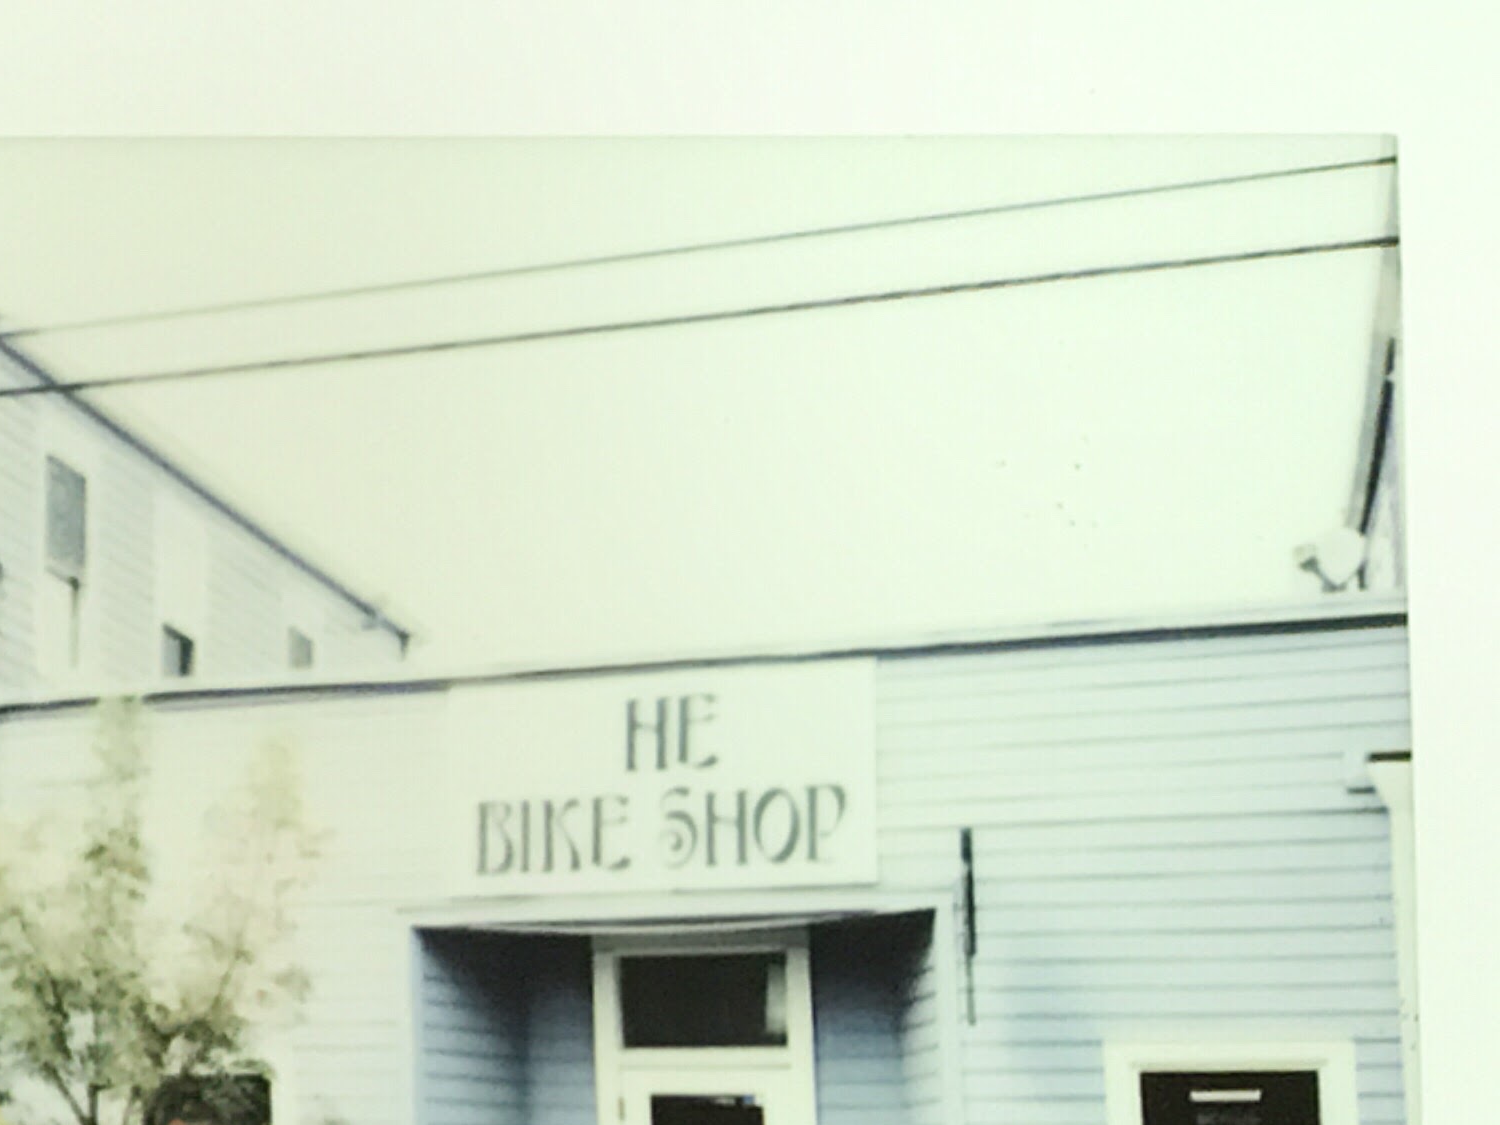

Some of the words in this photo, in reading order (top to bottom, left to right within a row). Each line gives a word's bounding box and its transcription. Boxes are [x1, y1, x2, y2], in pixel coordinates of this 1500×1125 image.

[626, 693, 719, 771] HE
[476, 795, 632, 875] BIKE
[661, 785, 847, 869] SHOP
